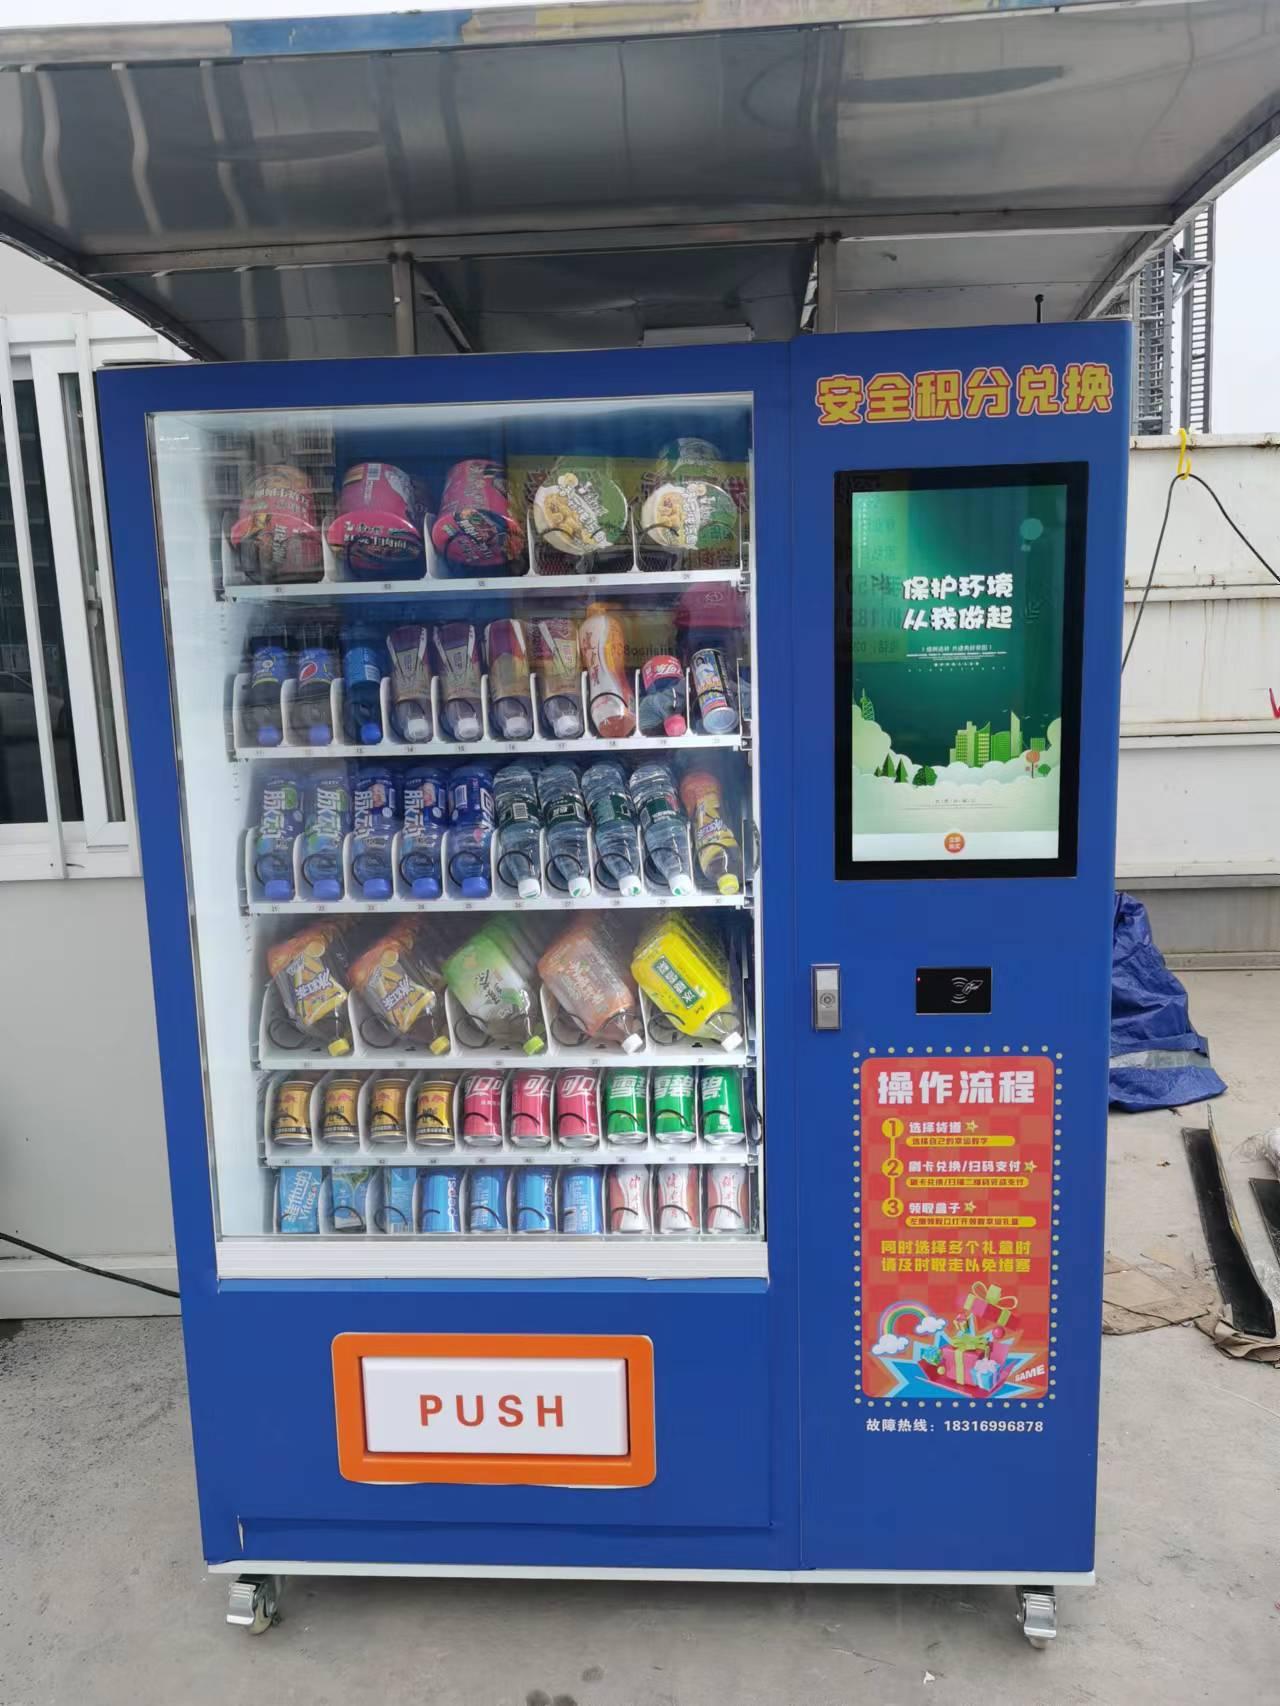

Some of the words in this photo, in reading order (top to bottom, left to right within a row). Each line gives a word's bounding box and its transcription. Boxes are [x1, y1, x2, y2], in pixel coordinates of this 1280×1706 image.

[816, 362, 1113, 426] 安全积分兑换
[903, 573, 1013, 600] 保护环境
[903, 605, 1012, 630] 从我做起
[878, 1070, 1035, 1105] 操作流程
[909, 1121, 961, 1134] 选择货道
[887, 1160, 898, 1175] 2
[887, 1200, 898, 1215] 3
[881, 1240, 1031, 1255] 同时选择多个礼盒时
[419, 1394, 564, 1427] PUSH
[944, 1420, 1044, 1432] 18316996878
